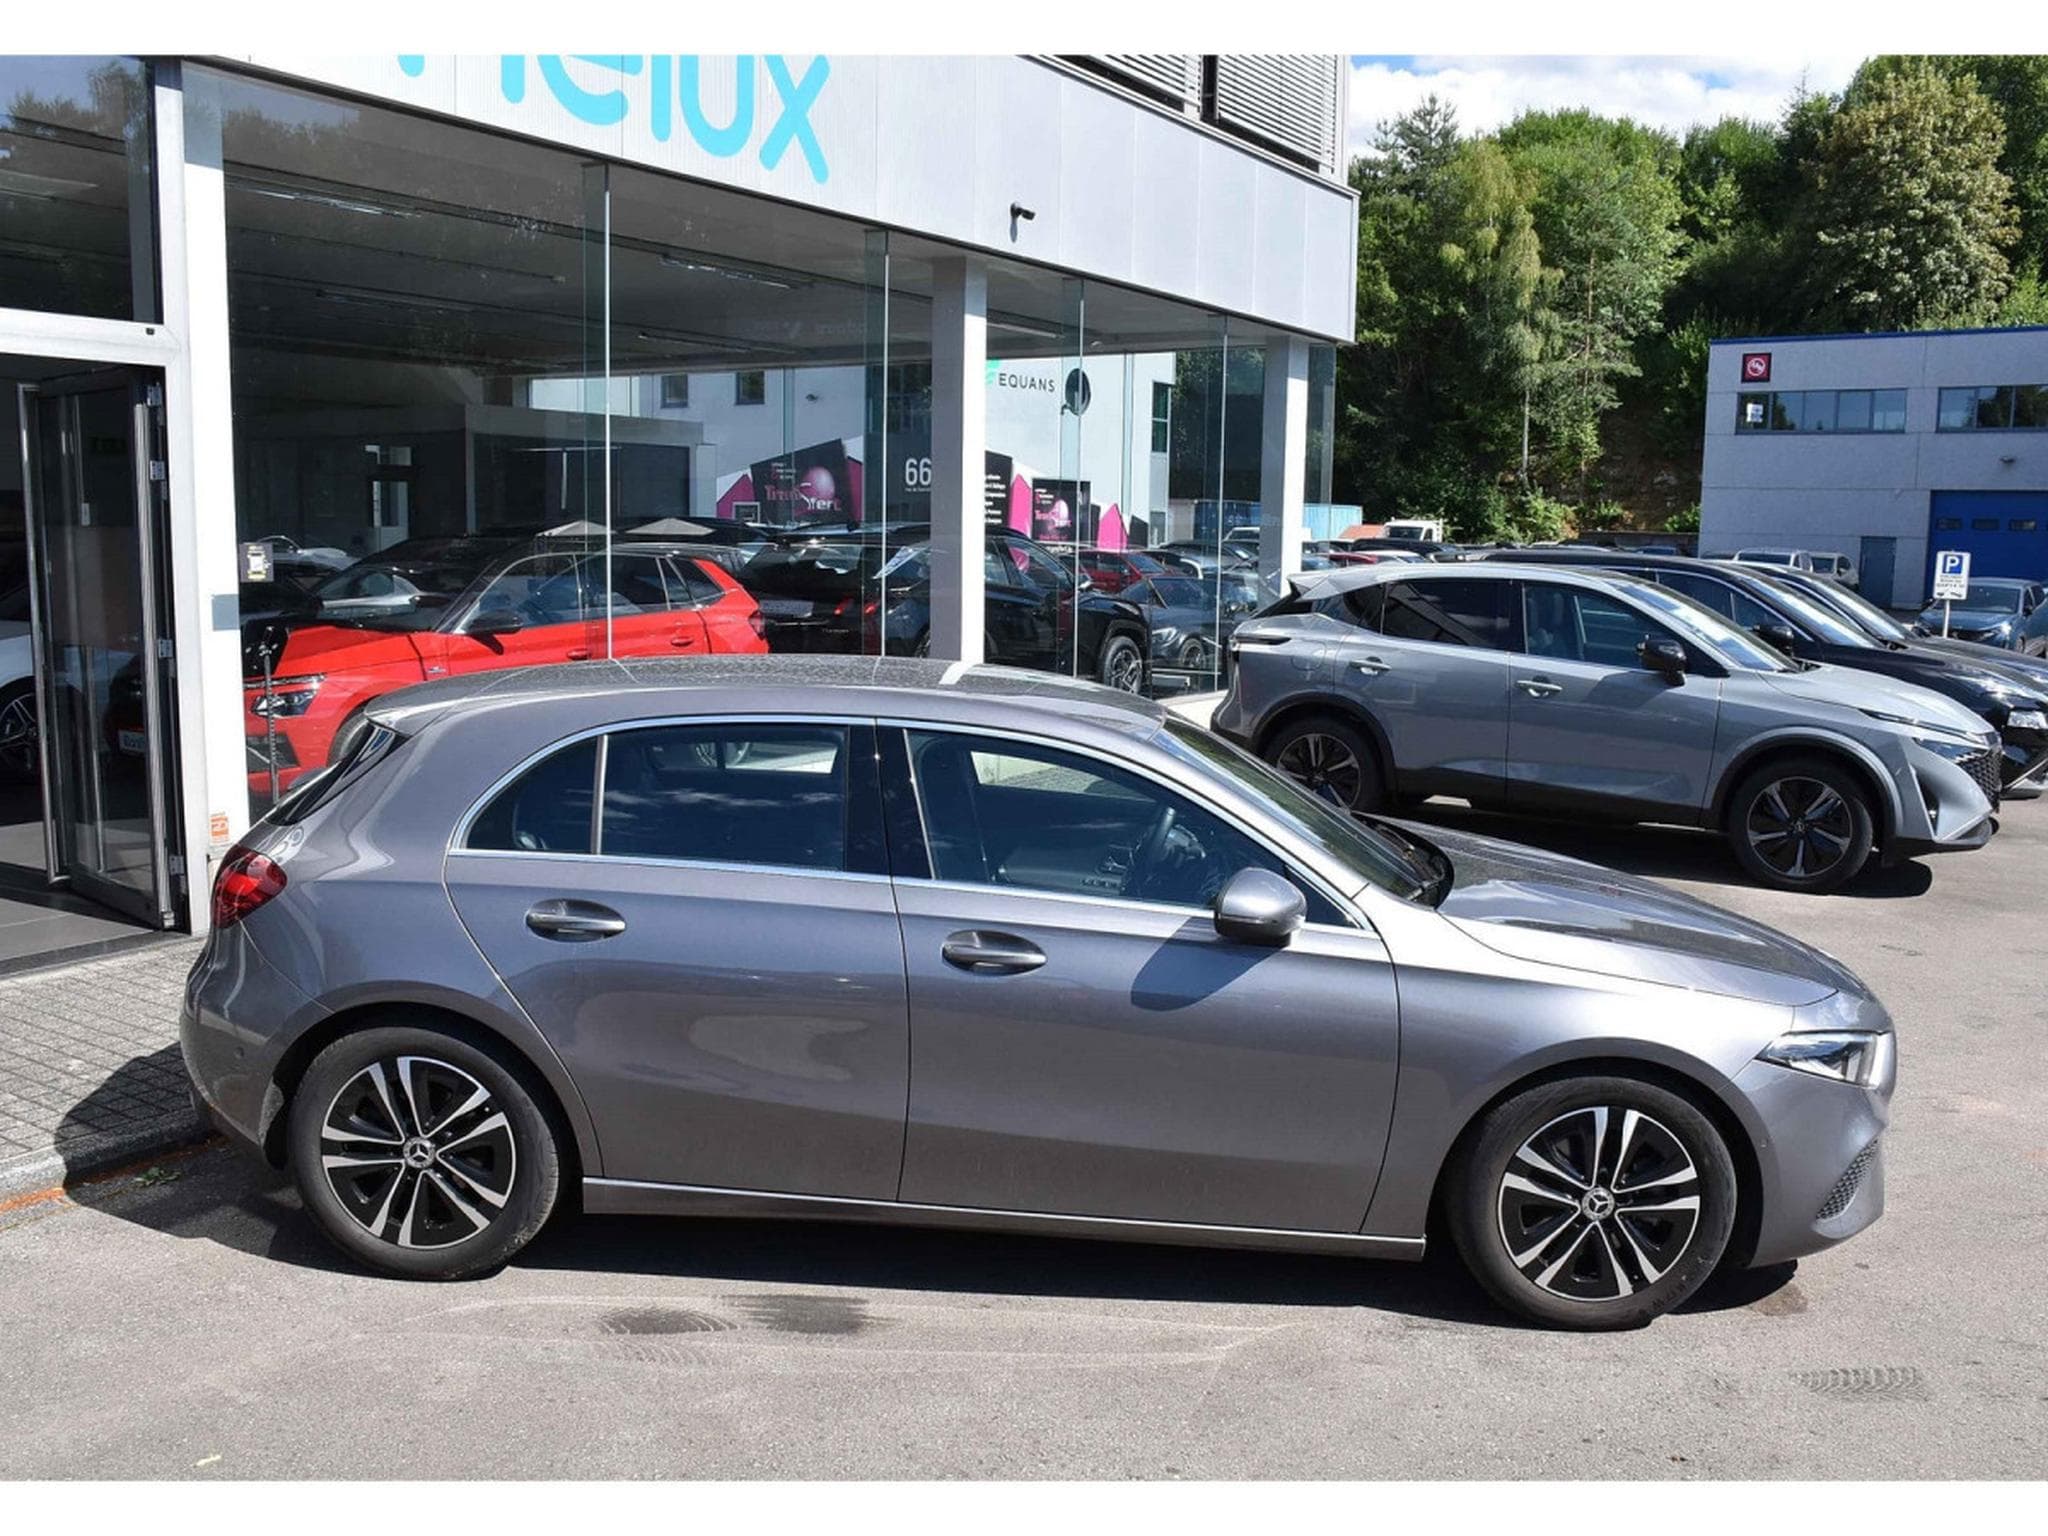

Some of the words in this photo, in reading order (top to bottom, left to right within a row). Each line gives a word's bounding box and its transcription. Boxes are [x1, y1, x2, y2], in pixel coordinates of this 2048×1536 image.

[998, 373, 1055, 393] EQUANS
[905, 458, 931, 486] 66
[1945, 556, 1960, 573] P
